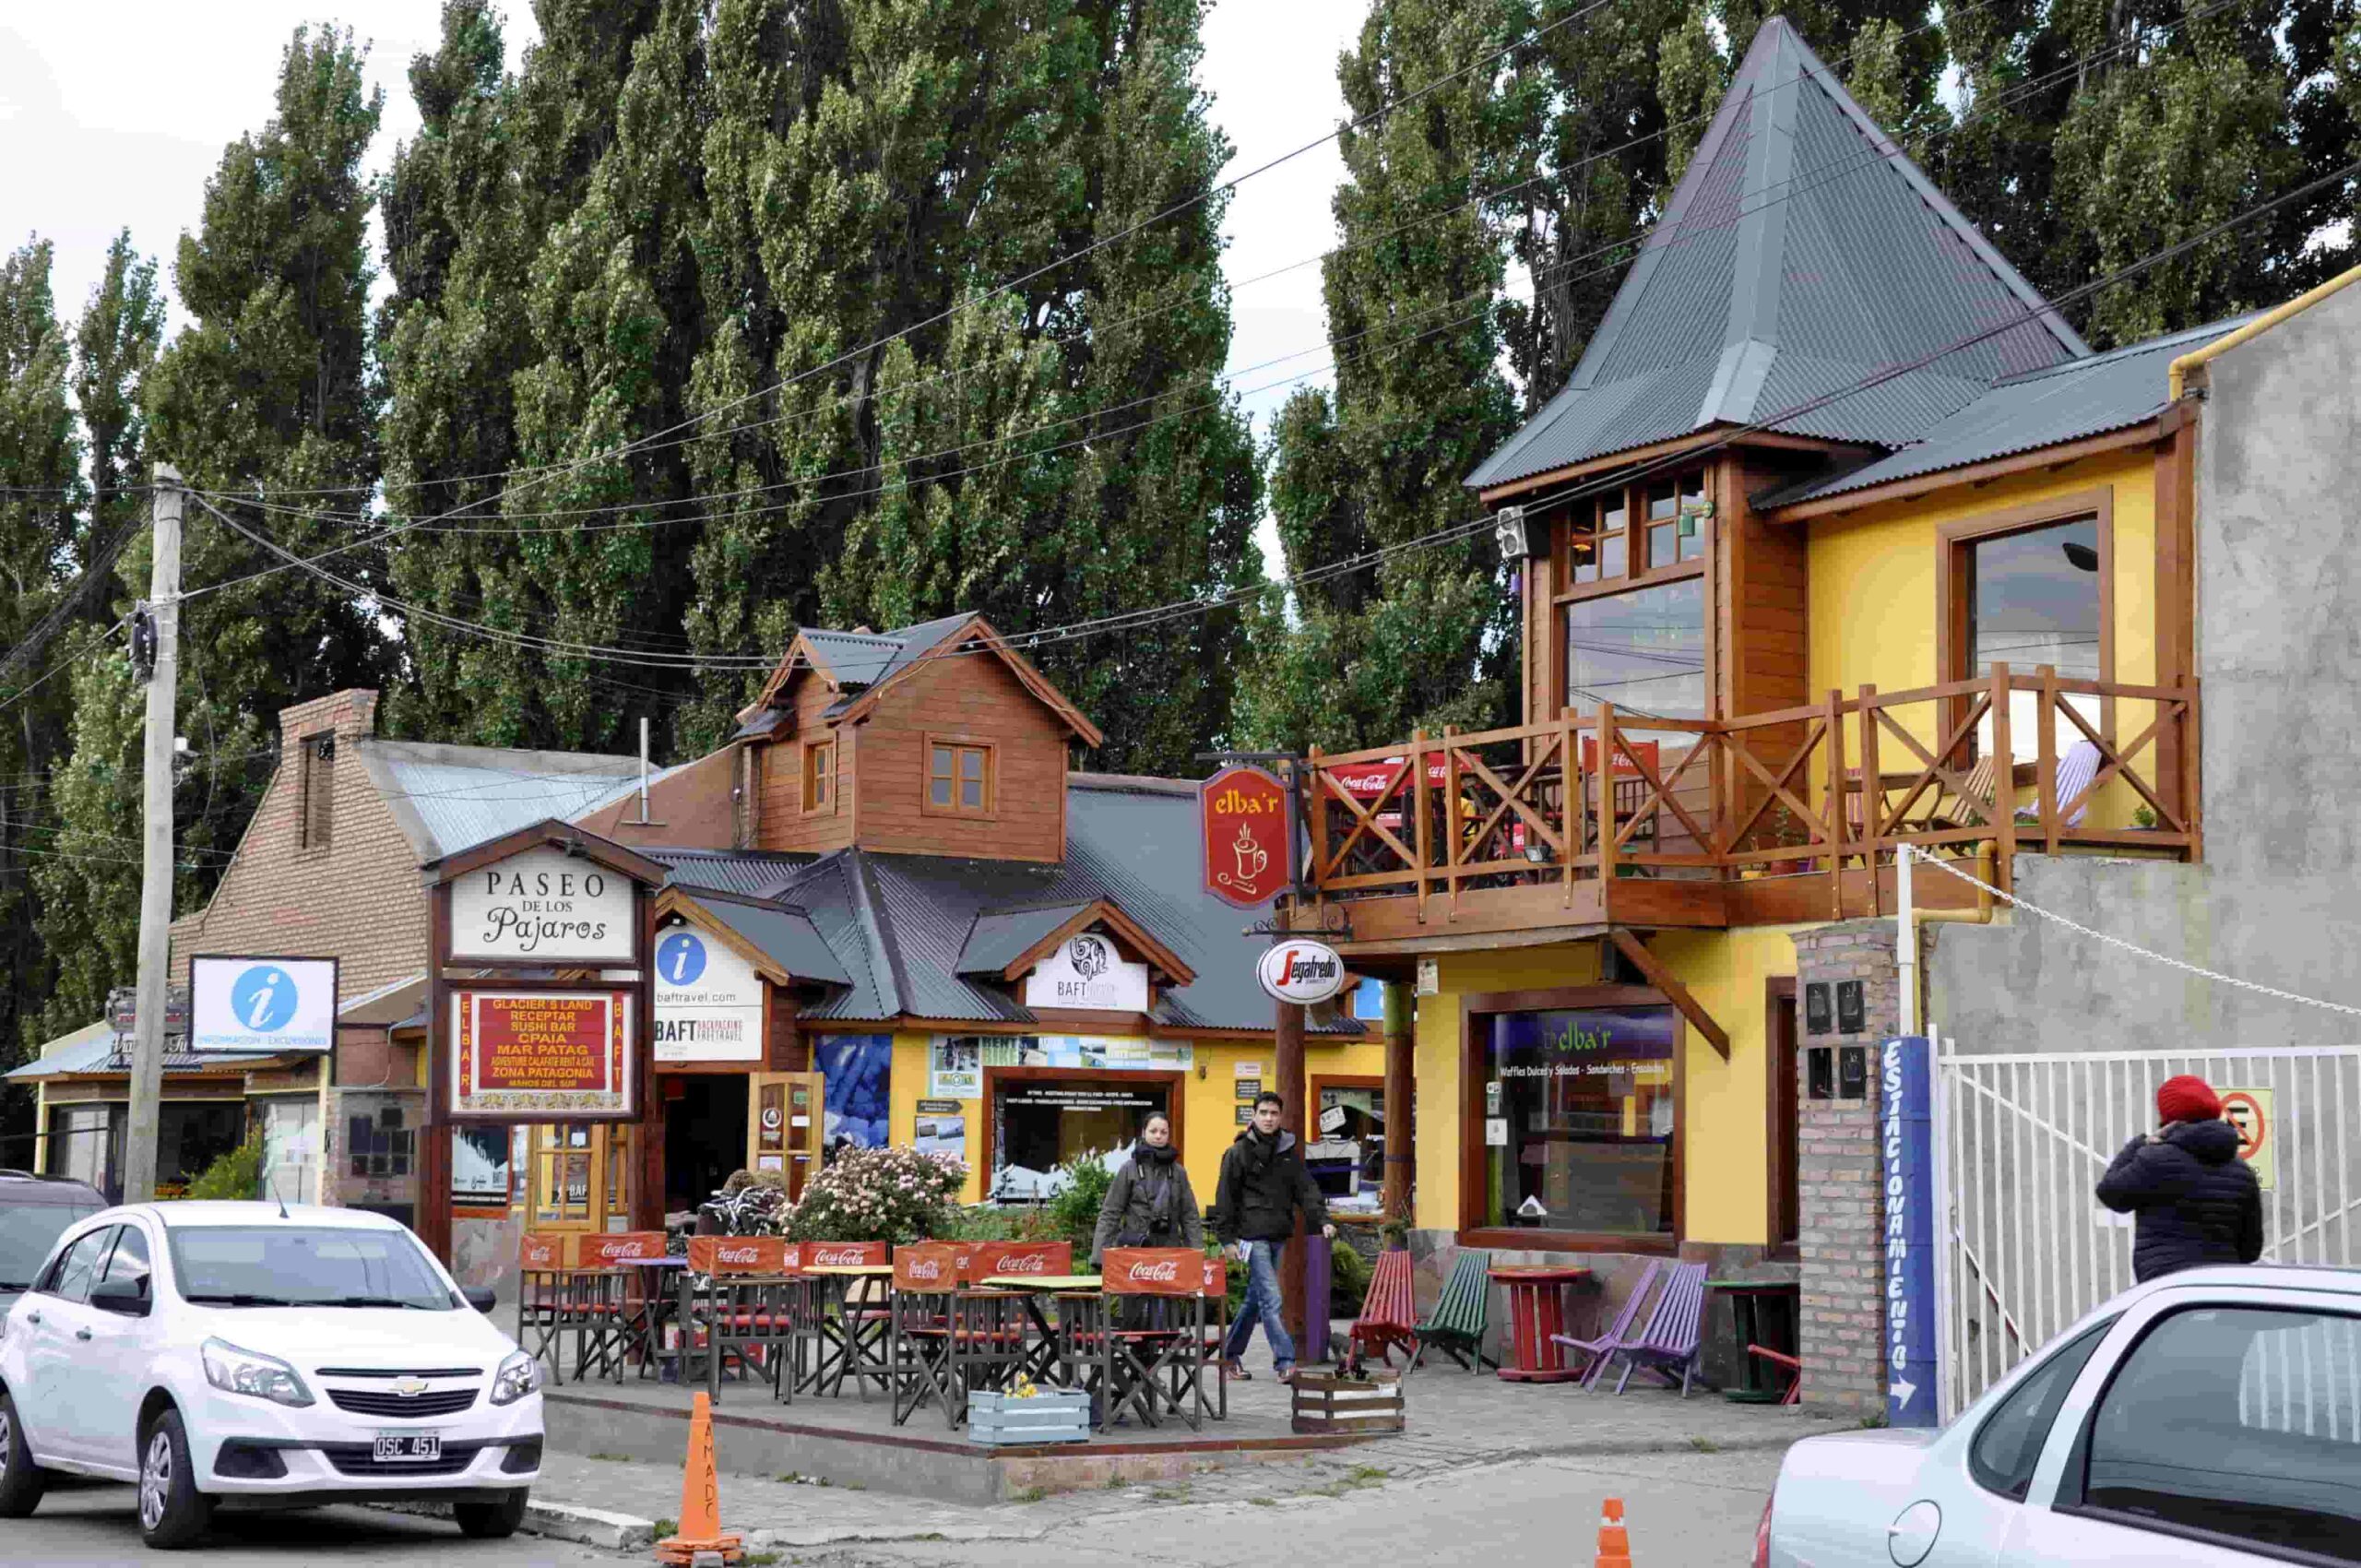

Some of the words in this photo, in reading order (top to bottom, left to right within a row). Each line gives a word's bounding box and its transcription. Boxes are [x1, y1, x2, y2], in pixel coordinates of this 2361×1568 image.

[486, 872, 604, 897] PASEO
[522, 900, 541, 912] DE
[546, 900, 573, 912] LOS
[482, 907, 607, 952] Pajaros
[1275, 949, 1336, 987] Segafredo
[1057, 981, 1086, 996] BAFT
[560, 1000, 593, 1011] LAND
[657, 992, 736, 1004] baftravel.com
[510, 1010, 575, 1022] RECEPTAR
[510, 1021, 547, 1032] SUSHI
[551, 1021, 575, 1032] BAR
[654, 1019, 696, 1042] BAFT
[497, 1044, 533, 1055] MAR
[538, 1044, 588, 1056] PATAG
[981, 1036, 1018, 1049] RENT
[492, 1066, 525, 1078] ZONA
[528, 1067, 595, 1078] PATAGONIA
[1500, 1065, 1526, 1077] Waffles
[601, 1241, 644, 1258] Coca-Cola
[814, 1248, 865, 1265] Coca-Cola
[996, 1253, 1046, 1273] Coca-Cola
[1128, 1260, 1181, 1282] Coca-Cola
[410, 1437, 439, 1455] 451
